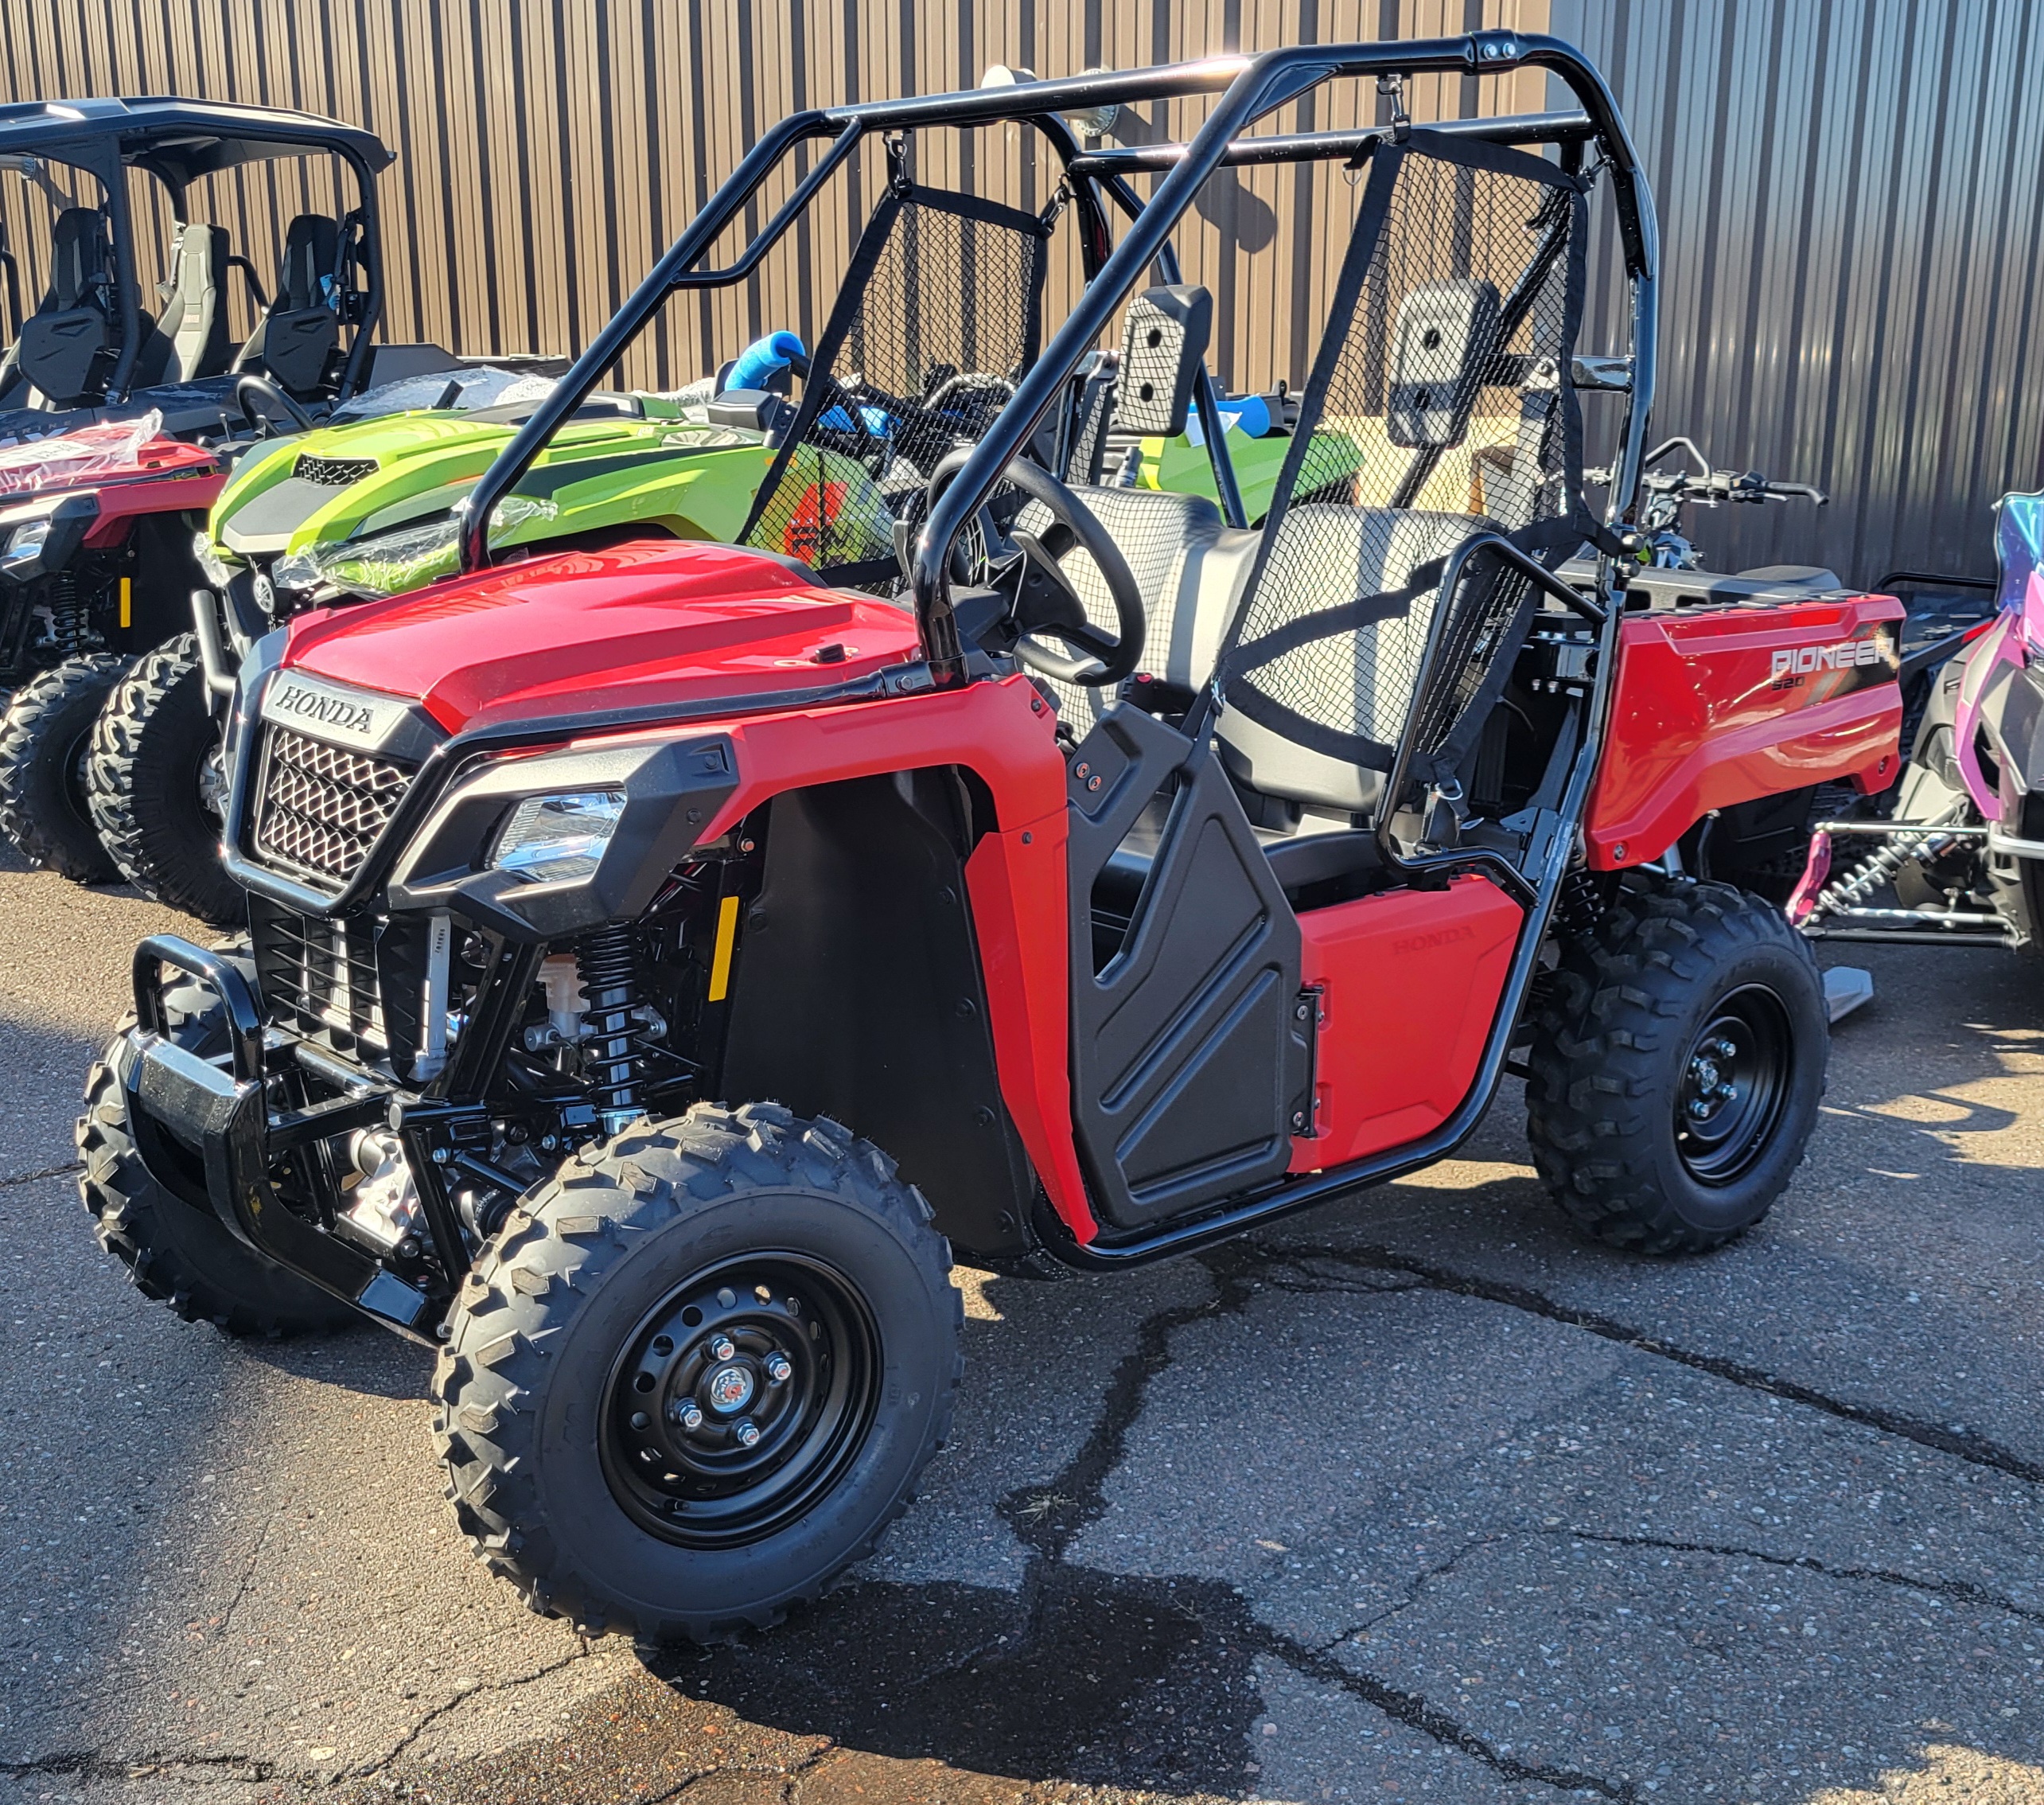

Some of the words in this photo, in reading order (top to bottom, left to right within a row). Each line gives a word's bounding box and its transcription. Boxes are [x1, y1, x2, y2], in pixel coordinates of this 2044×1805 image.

[1771, 637, 1894, 678] PIONEER
[1771, 676, 1805, 691] 520
[275, 685, 374, 734] HONDA
[1392, 925, 1476, 955] HONDA
